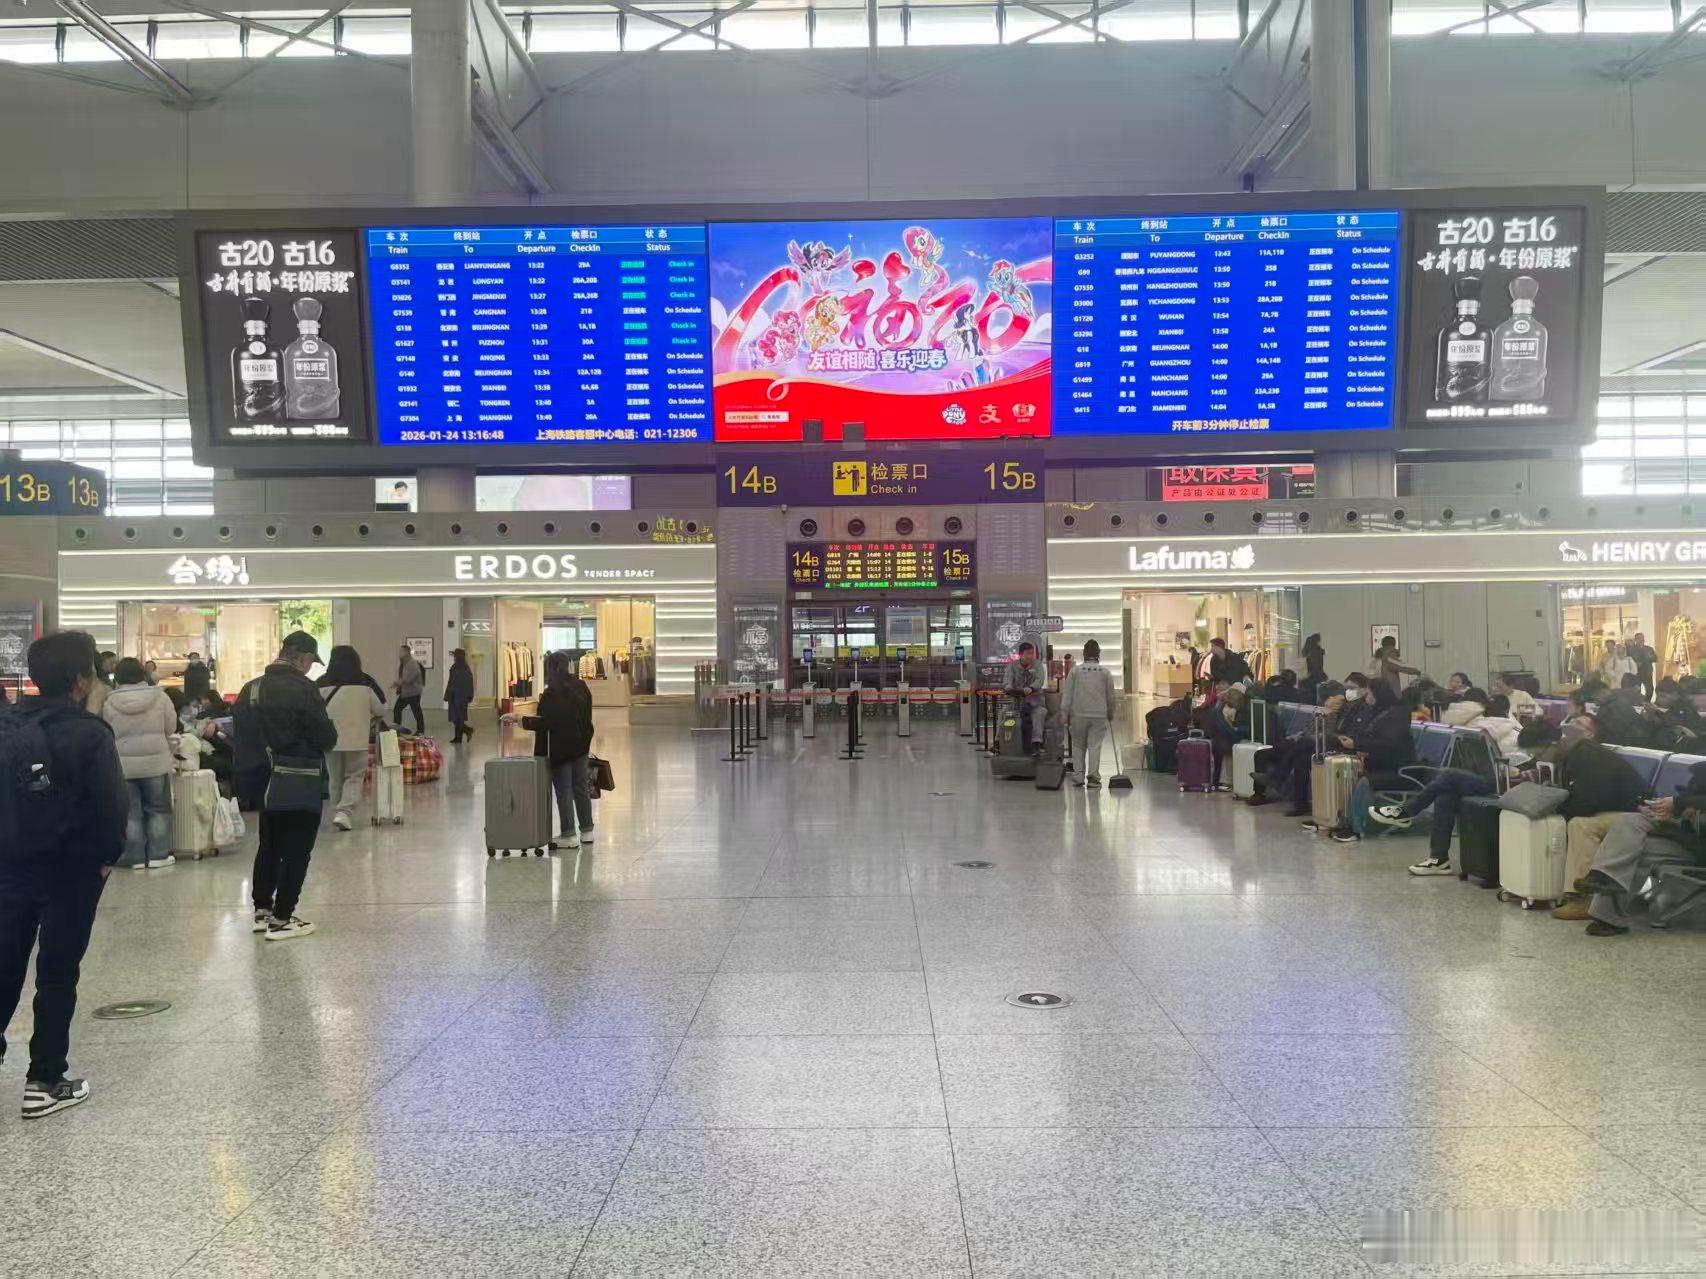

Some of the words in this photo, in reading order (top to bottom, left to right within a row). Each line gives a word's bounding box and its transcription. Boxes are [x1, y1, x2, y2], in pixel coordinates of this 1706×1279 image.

[1141, 220, 1168, 230] 终到站
[1261, 217, 1288, 227] 检票口
[454, 231, 481, 241] 终到站
[571, 230, 598, 240] 检票口
[1073, 235, 1094, 244] Train
[1150, 234, 1161, 242] To
[1205, 232, 1245, 243] Departure
[1258, 230, 1290, 240] CheckIn
[1336, 229, 1362, 238] Status
[1437, 216, 1495, 245] 古20
[1502, 216, 1558, 243] 古16
[218, 240, 275, 267] 古20
[281, 240, 337, 266] 古16
[388, 245, 408, 254] Train
[517, 244, 557, 255] Departure
[570, 243, 601, 252] CheckIn
[646, 243, 671, 252] Status
[1149, 250, 1196, 259] PUYANGDONG
[1351, 246, 1361, 255] On
[1362, 245, 1391, 255] Schedule
[463, 262, 511, 270] LIANYUNGANG
[1350, 262, 1360, 270] On
[1361, 261, 1390, 270] Schedule
[472, 277, 504, 285] LONGYAN
[1361, 277, 1390, 285] Schedule
[1147, 297, 1196, 305] YICHANGDONG
[1349, 293, 1359, 301] On
[1360, 292, 1389, 301] Schedule
[473, 308, 507, 316] CANGNAN
[1158, 313, 1185, 321] WUHAN
[1349, 309, 1359, 317] On
[1360, 308, 1389, 317] Schedule
[471, 323, 510, 331] BEIJINGNAN
[1348, 324, 1358, 332] On
[1359, 323, 1388, 332] Schedule
[1151, 343, 1190, 352] BEIJINGNAN
[1359, 339, 1388, 347] Schedule
[479, 354, 506, 362] ANQING
[808, 349, 876, 371] 友谊相随
[880, 349, 947, 372] 喜乐迎春
[1149, 359, 1192, 367] GUANGZHOU
[1347, 355, 1357, 363] On
[1358, 354, 1387, 363] Schedule
[1151, 374, 1189, 382] NANCHANG
[1211, 373, 1228, 381] 14:00
[1346, 370, 1356, 378] On
[1357, 369, 1386, 378] Schedule
[1150, 389, 1189, 397] NANCHANG
[1356, 385, 1385, 393] Schedule
[479, 399, 511, 407] TONGREN
[1151, 404, 1187, 412] XIAMENBEI
[1356, 400, 1385, 408] Schedule
[478, 414, 513, 422] SHANGHAI
[1171, 418, 1270, 432] 开车前3分钟停止检票
[400, 430, 459, 441] 2026-01-24
[461, 430, 505, 441] 13:16:48
[643, 429, 698, 439] 021-12306
[871, 463, 928, 481] 检票口
[983, 462, 1037, 491] 15B
[724, 465, 777, 494] 14B
[68, 476, 99, 507] 13B
[871, 484, 903, 495] Check
[907, 484, 917, 494] in
[1171, 487, 1261, 497] 产品由公证处公证
[942, 548, 970, 565] 15B
[1592, 541, 1671, 562] HENRY
[792, 550, 820, 567] 14B
[1128, 546, 1228, 571] Lafuma
[454, 554, 578, 580] ERDOS
[792, 568, 820, 578] 检票口
[943, 566, 971, 577] 检票口
[584, 569, 621, 578] TENDER
[624, 569, 655, 578] SPACE
